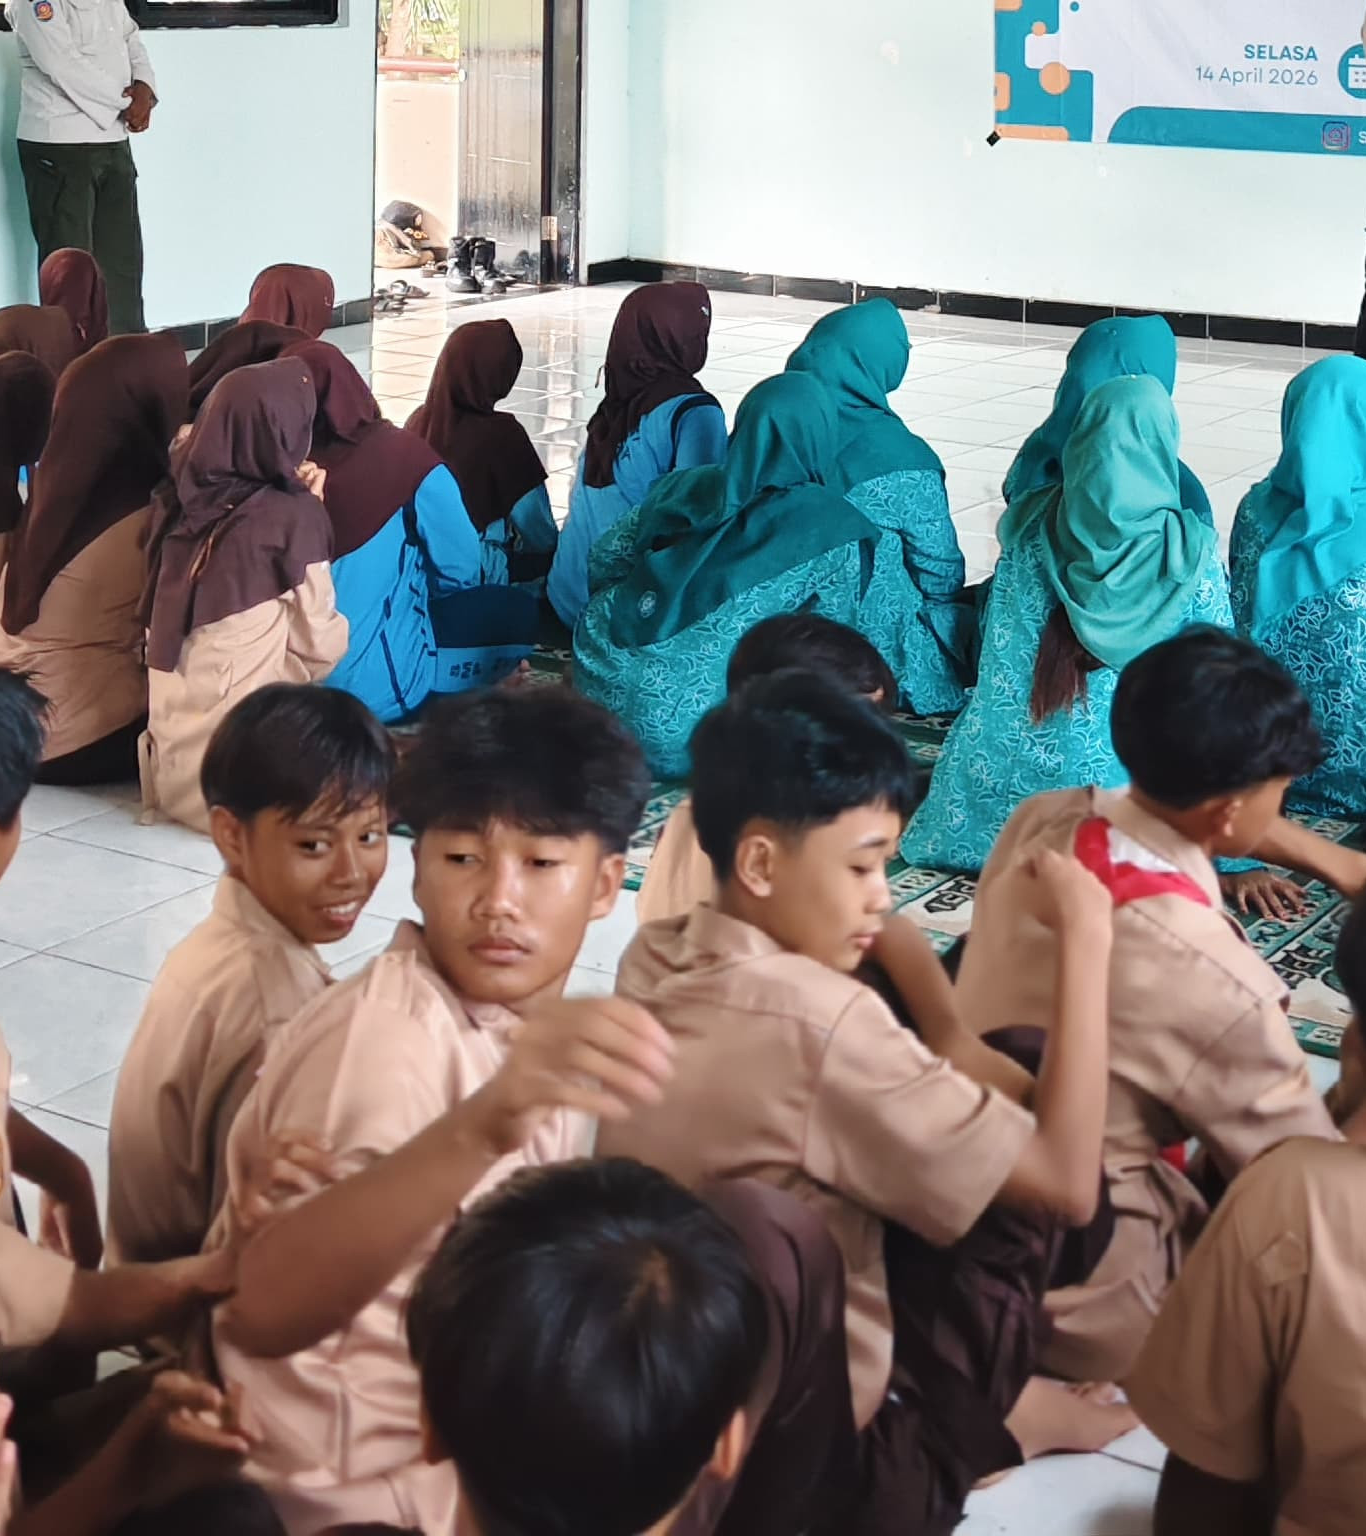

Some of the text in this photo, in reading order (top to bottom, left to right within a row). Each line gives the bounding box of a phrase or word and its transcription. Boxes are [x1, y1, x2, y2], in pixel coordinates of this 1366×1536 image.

[1244, 44, 1318, 62] SELASA
[1196, 66, 1319, 86] 14 April 2026
